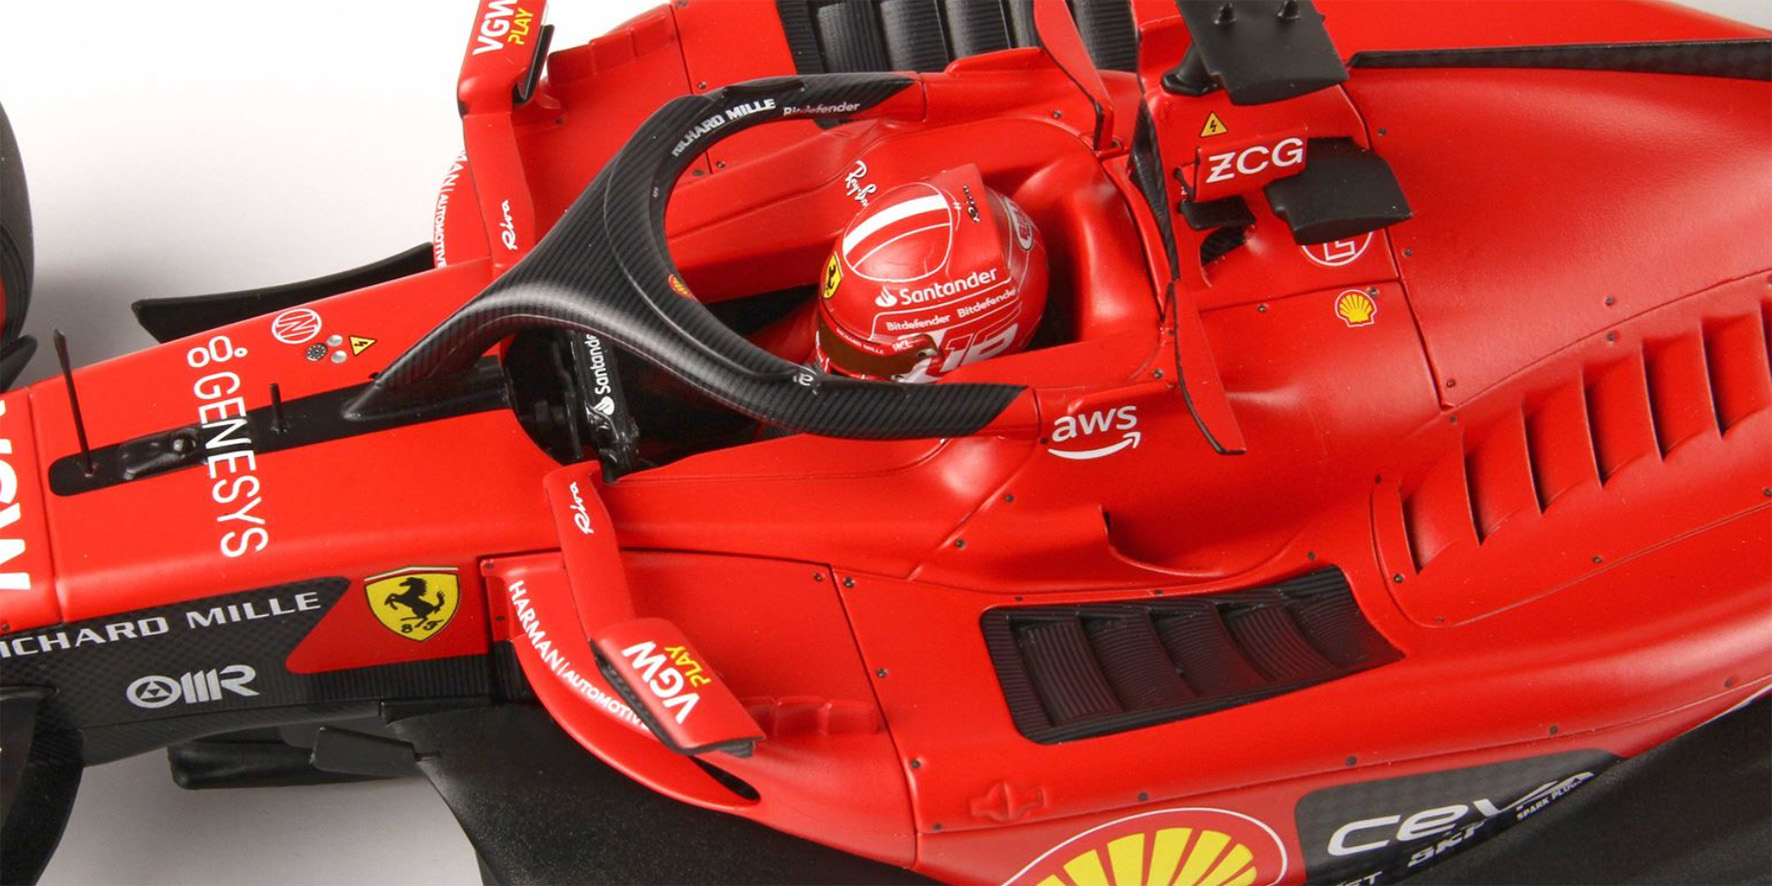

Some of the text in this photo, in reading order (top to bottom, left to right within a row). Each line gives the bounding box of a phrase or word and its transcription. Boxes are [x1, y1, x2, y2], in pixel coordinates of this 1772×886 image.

[508, 7, 534, 45] PLAY
[726, 98, 777, 122] MILLE
[899, 267, 998, 306] Santander
[886, 286, 1017, 332] Bitdefender Bitdefende
[584, 333, 612, 395] Santande
[1052, 405, 1138, 442] aws
[193, 371, 269, 558] GENESYS
[0, 590, 322, 660] ICHARD MILLE
[508, 580, 651, 735] HARMAN AUTOMOTIV
[664, 646, 712, 688] PLAY
[621, 639, 701, 725] VGW
[1516, 797, 1550, 821] SPARK
